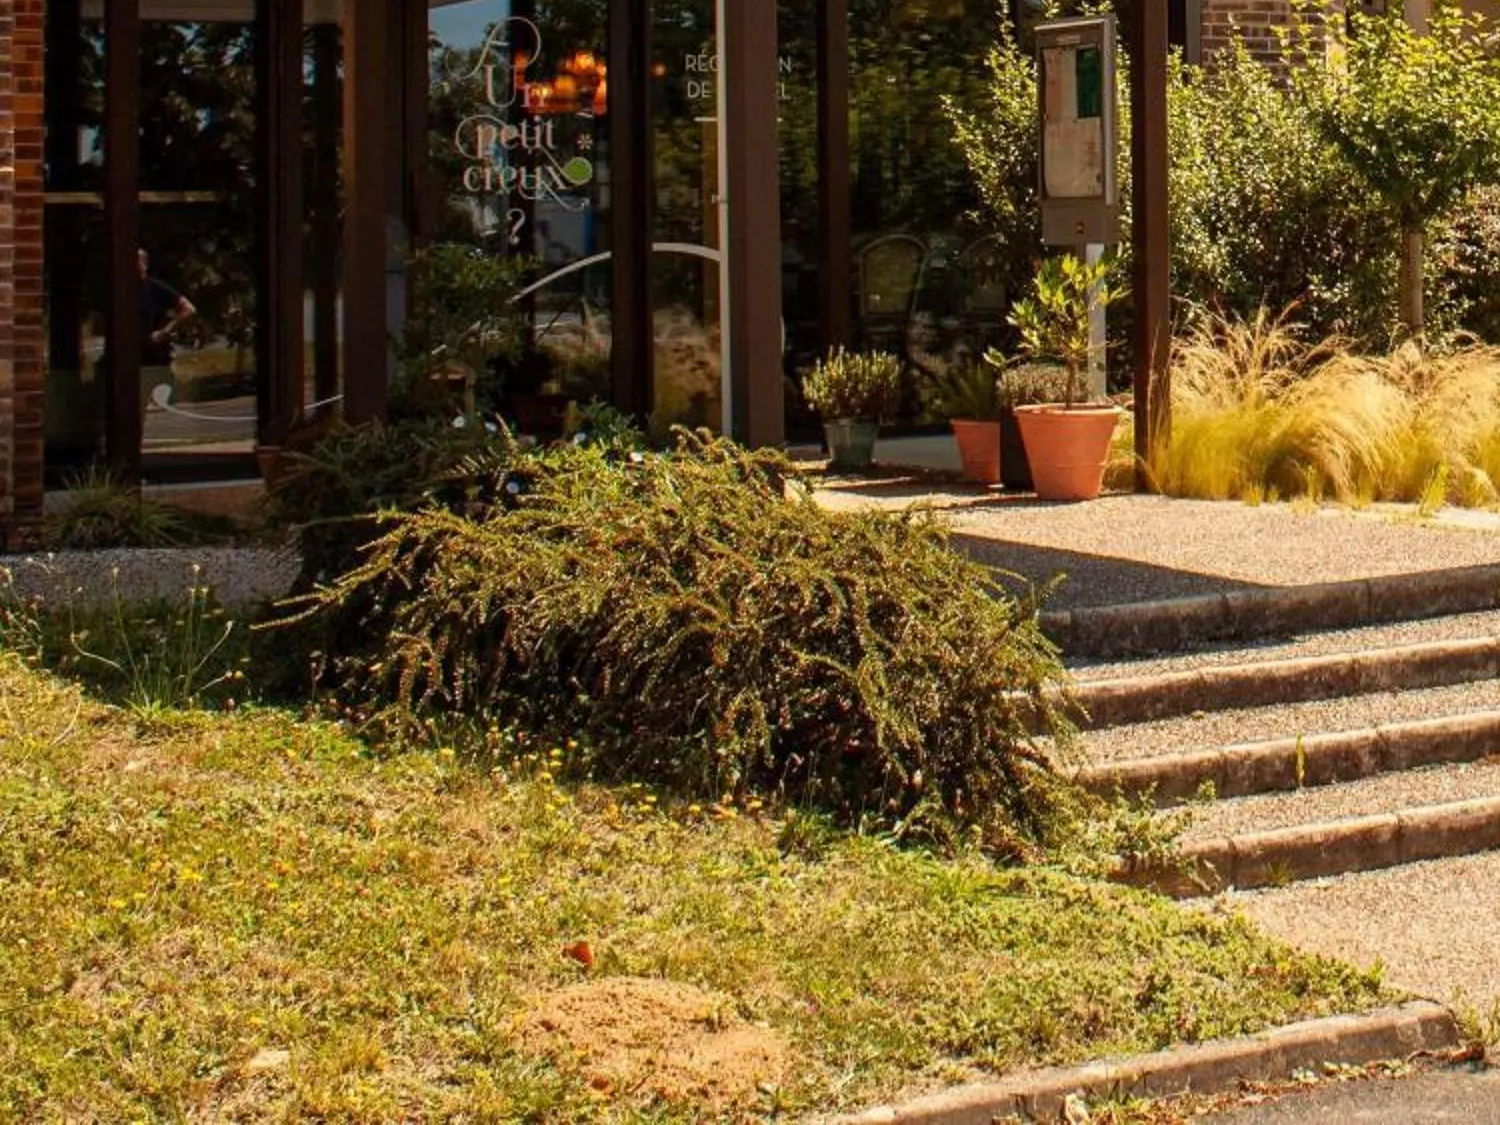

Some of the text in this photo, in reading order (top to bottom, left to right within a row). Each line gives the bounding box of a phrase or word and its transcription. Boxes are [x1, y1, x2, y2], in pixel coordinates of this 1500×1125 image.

[687, 80, 712, 99] DE
[457, 115, 557, 159] petit
[463, 163, 570, 200] creux
